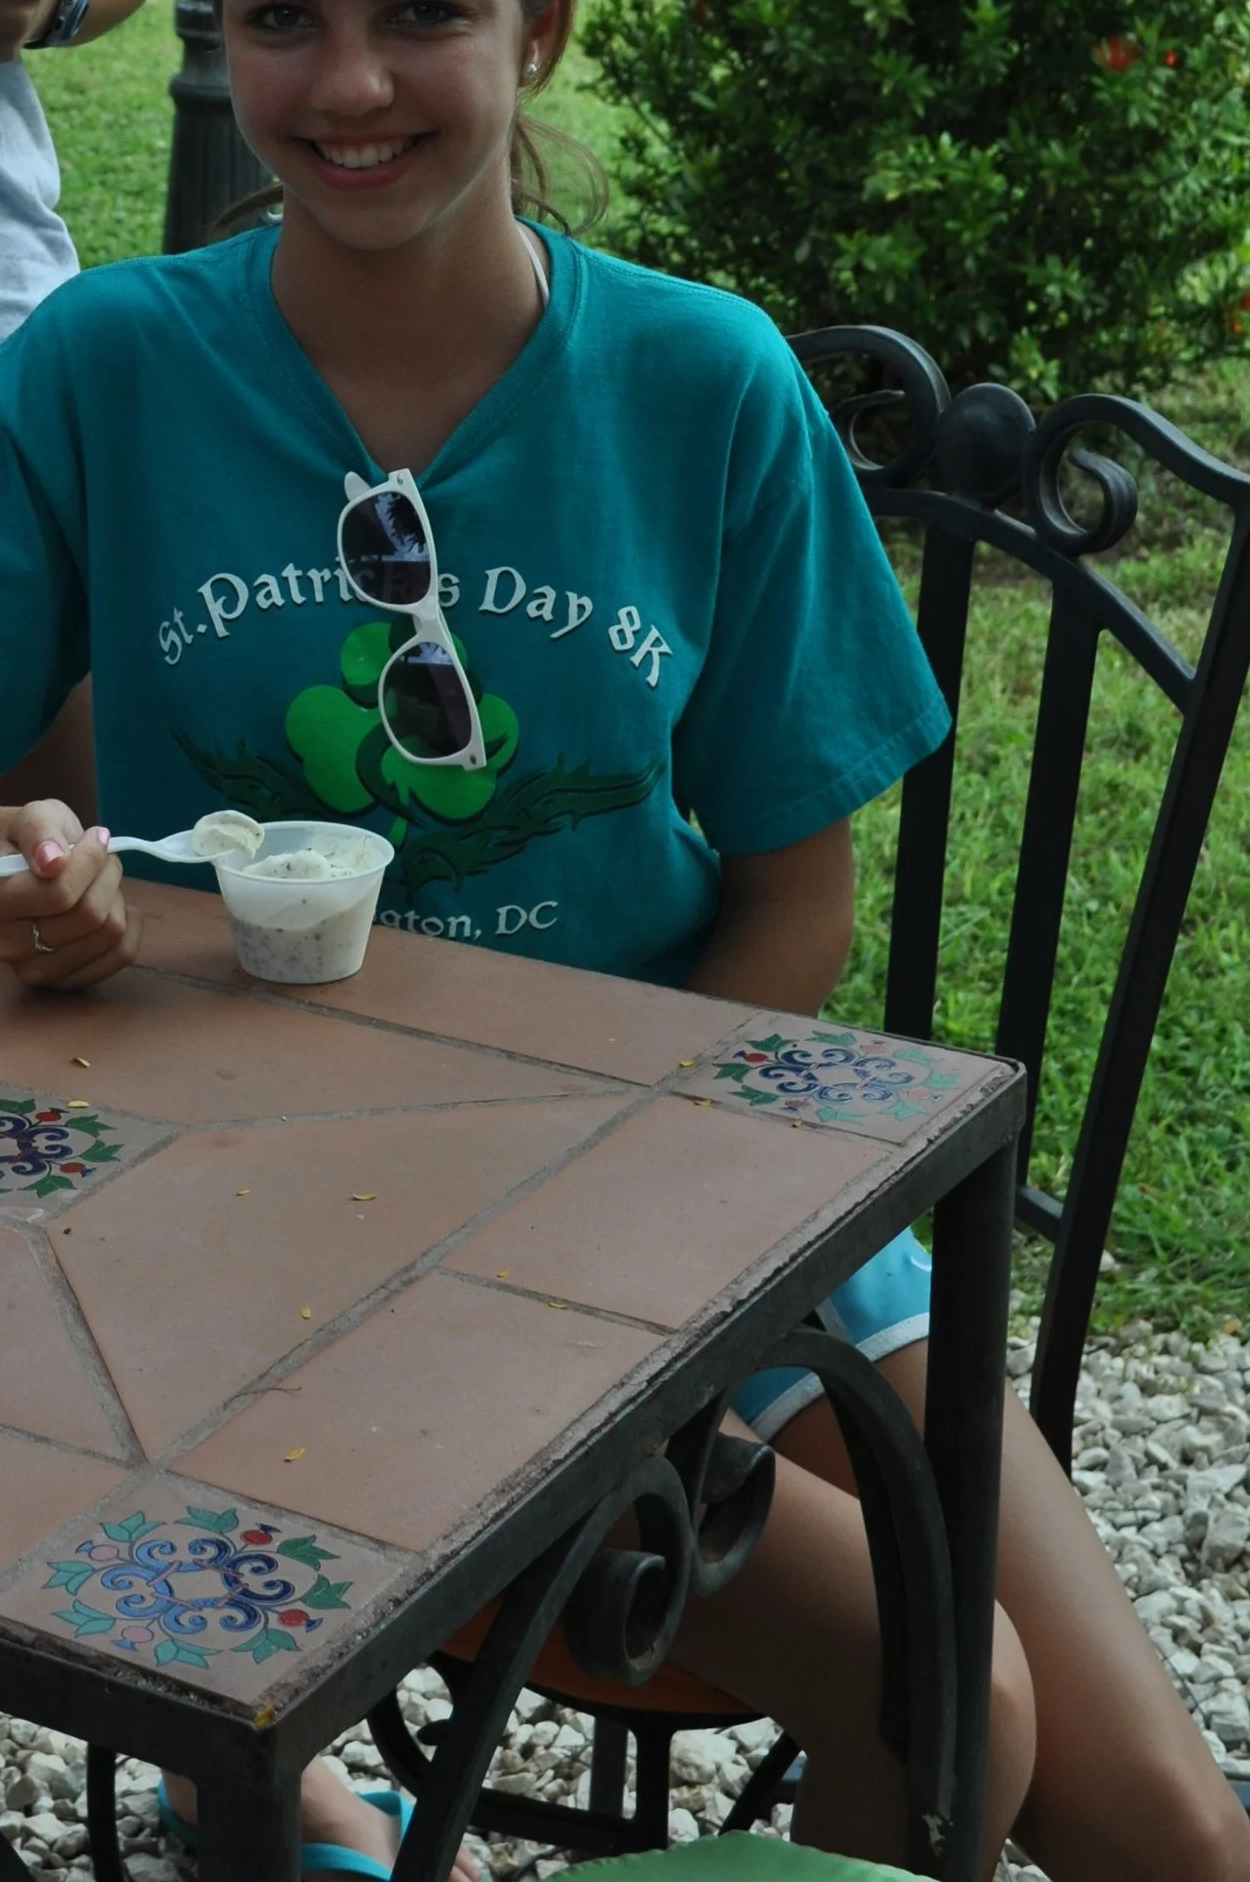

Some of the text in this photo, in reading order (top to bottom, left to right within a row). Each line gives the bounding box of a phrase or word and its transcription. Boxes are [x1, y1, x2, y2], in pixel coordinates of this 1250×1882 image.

[478, 566, 594, 639] Day
[608, 605, 674, 688] 8K
[494, 900, 559, 936] DC
